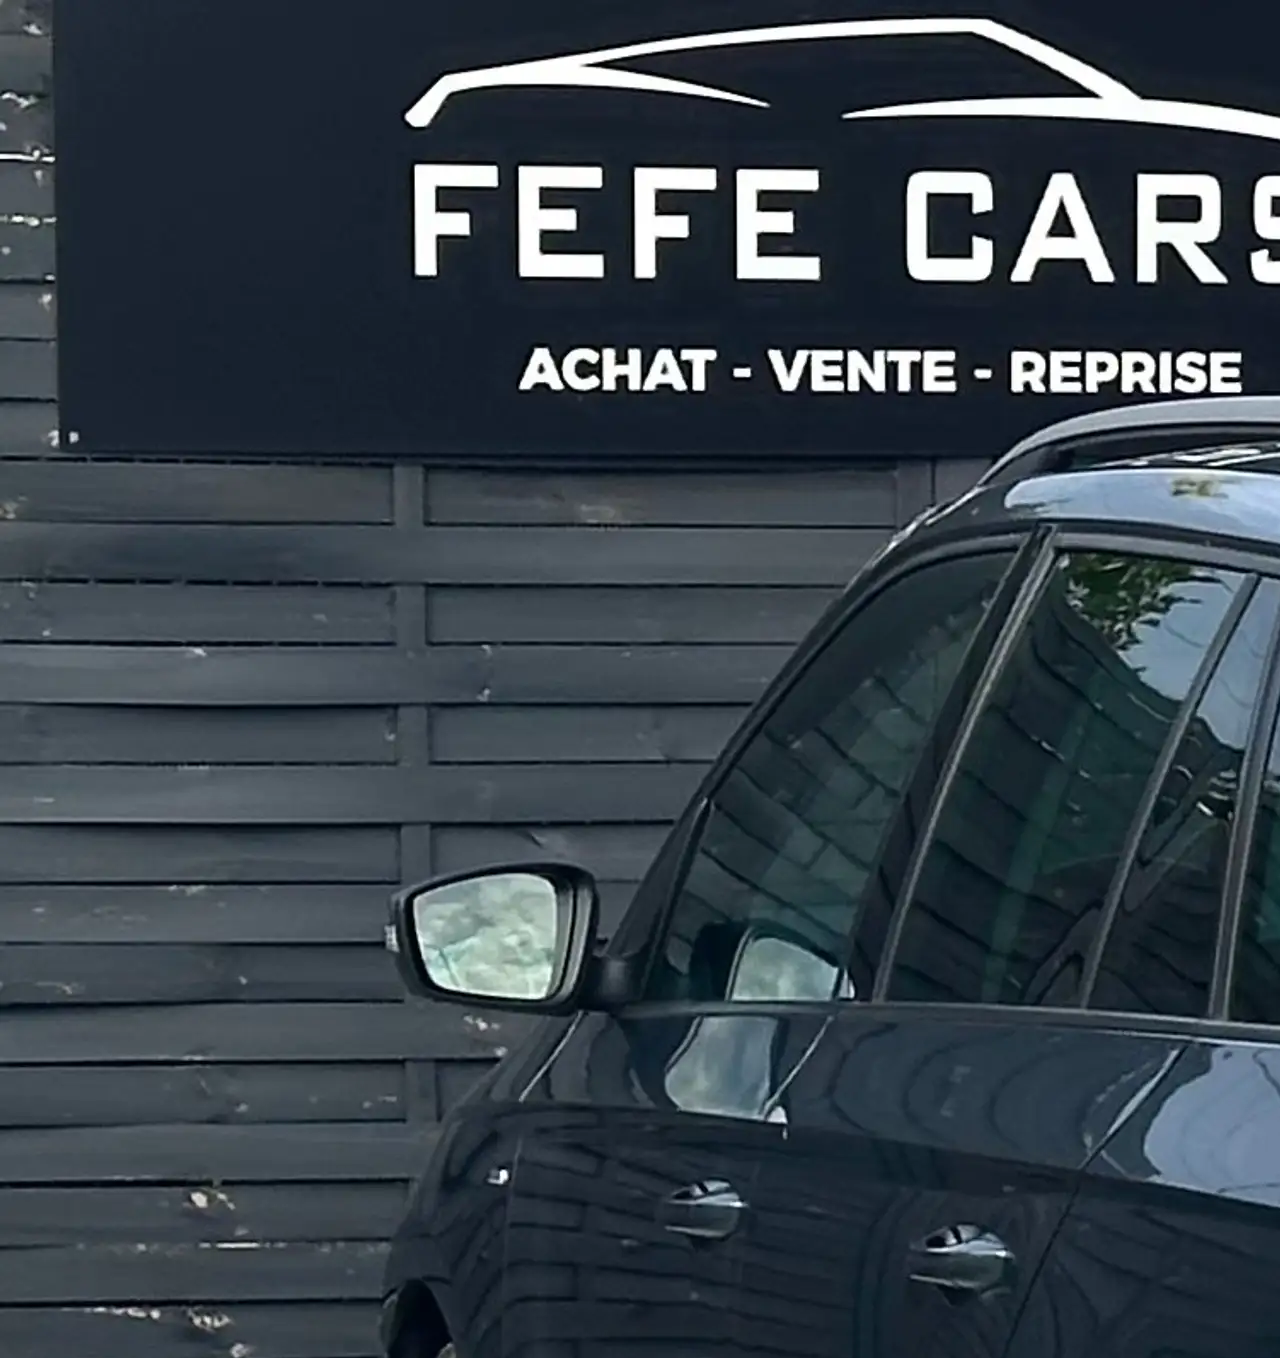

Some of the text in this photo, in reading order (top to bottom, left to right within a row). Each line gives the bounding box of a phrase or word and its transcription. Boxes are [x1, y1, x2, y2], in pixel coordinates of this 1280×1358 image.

[412, 163, 821, 282] FEFE
[518, 347, 718, 393] ACHAT
[767, 348, 957, 394] VENTE
[1010, 350, 1243, 395] REPRISE
